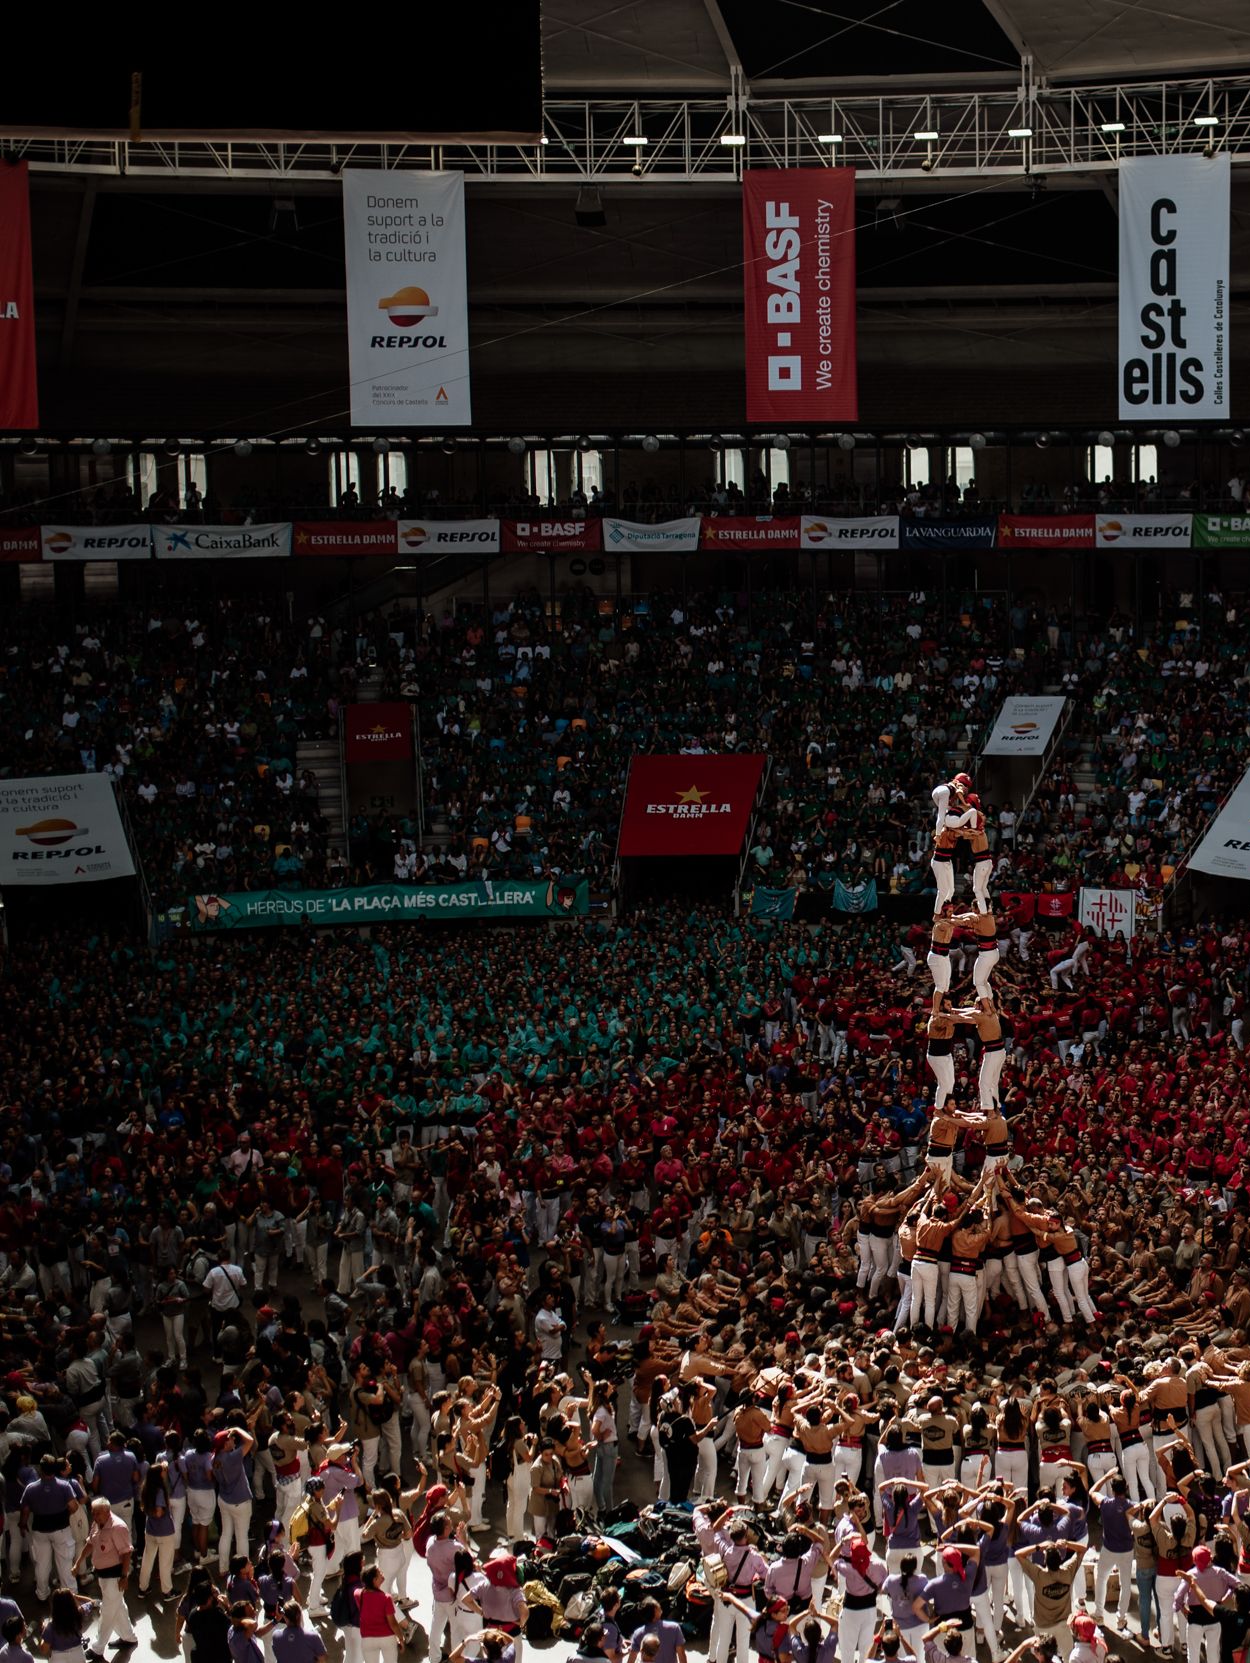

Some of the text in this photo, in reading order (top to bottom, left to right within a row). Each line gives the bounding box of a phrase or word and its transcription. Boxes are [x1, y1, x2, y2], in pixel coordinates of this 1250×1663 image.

[367, 195, 419, 209] Donem
[367, 212, 445, 229] suport a la
[368, 230, 430, 244] tradició i
[368, 248, 437, 262] la cultura
[765, 200, 801, 324] BASF
[814, 199, 834, 391] We create chemistry
[1213, 321, 1224, 332] de
[370, 335, 447, 349] REPSOL
[540, 521, 586, 536] BASF
[717, 528, 799, 541] ESTRELLA DAMM
[837, 527, 897, 539] REPSOL
[905, 526, 993, 538] LA VANGUARDIA
[1014, 527, 1093, 539] ESTRELLA DAMM
[1132, 526, 1191, 538] REPSOL
[83, 537, 149, 549] REPSOL
[194, 533, 280, 550] CaixaBank
[311, 534, 396, 546] ESTRELLA DAMM
[436, 531, 498, 543] REPSOL
[627, 531, 697, 543] Diputació Tarragona
[1207, 535, 1219, 544] We
[1220, 536, 1241, 544] create
[3, 540, 38, 551] DAMM
[516, 540, 526, 549] We
[355, 732, 402, 741] ESTRELLA
[0, 784, 85, 797] onem suport
[6, 797, 18, 805] la
[22, 792, 71, 804] tradició
[12, 804, 59, 813] cultura
[646, 802, 732, 814] ESTRELLA
[12, 845, 106, 860] REPSOL
[246, 899, 304, 915] HEREUS
[306, 898, 326, 913] DE
[354, 894, 402, 912] PLAÇA
[403, 891, 436, 908] MÉS
[438, 889, 536, 907] CASTLERA'
